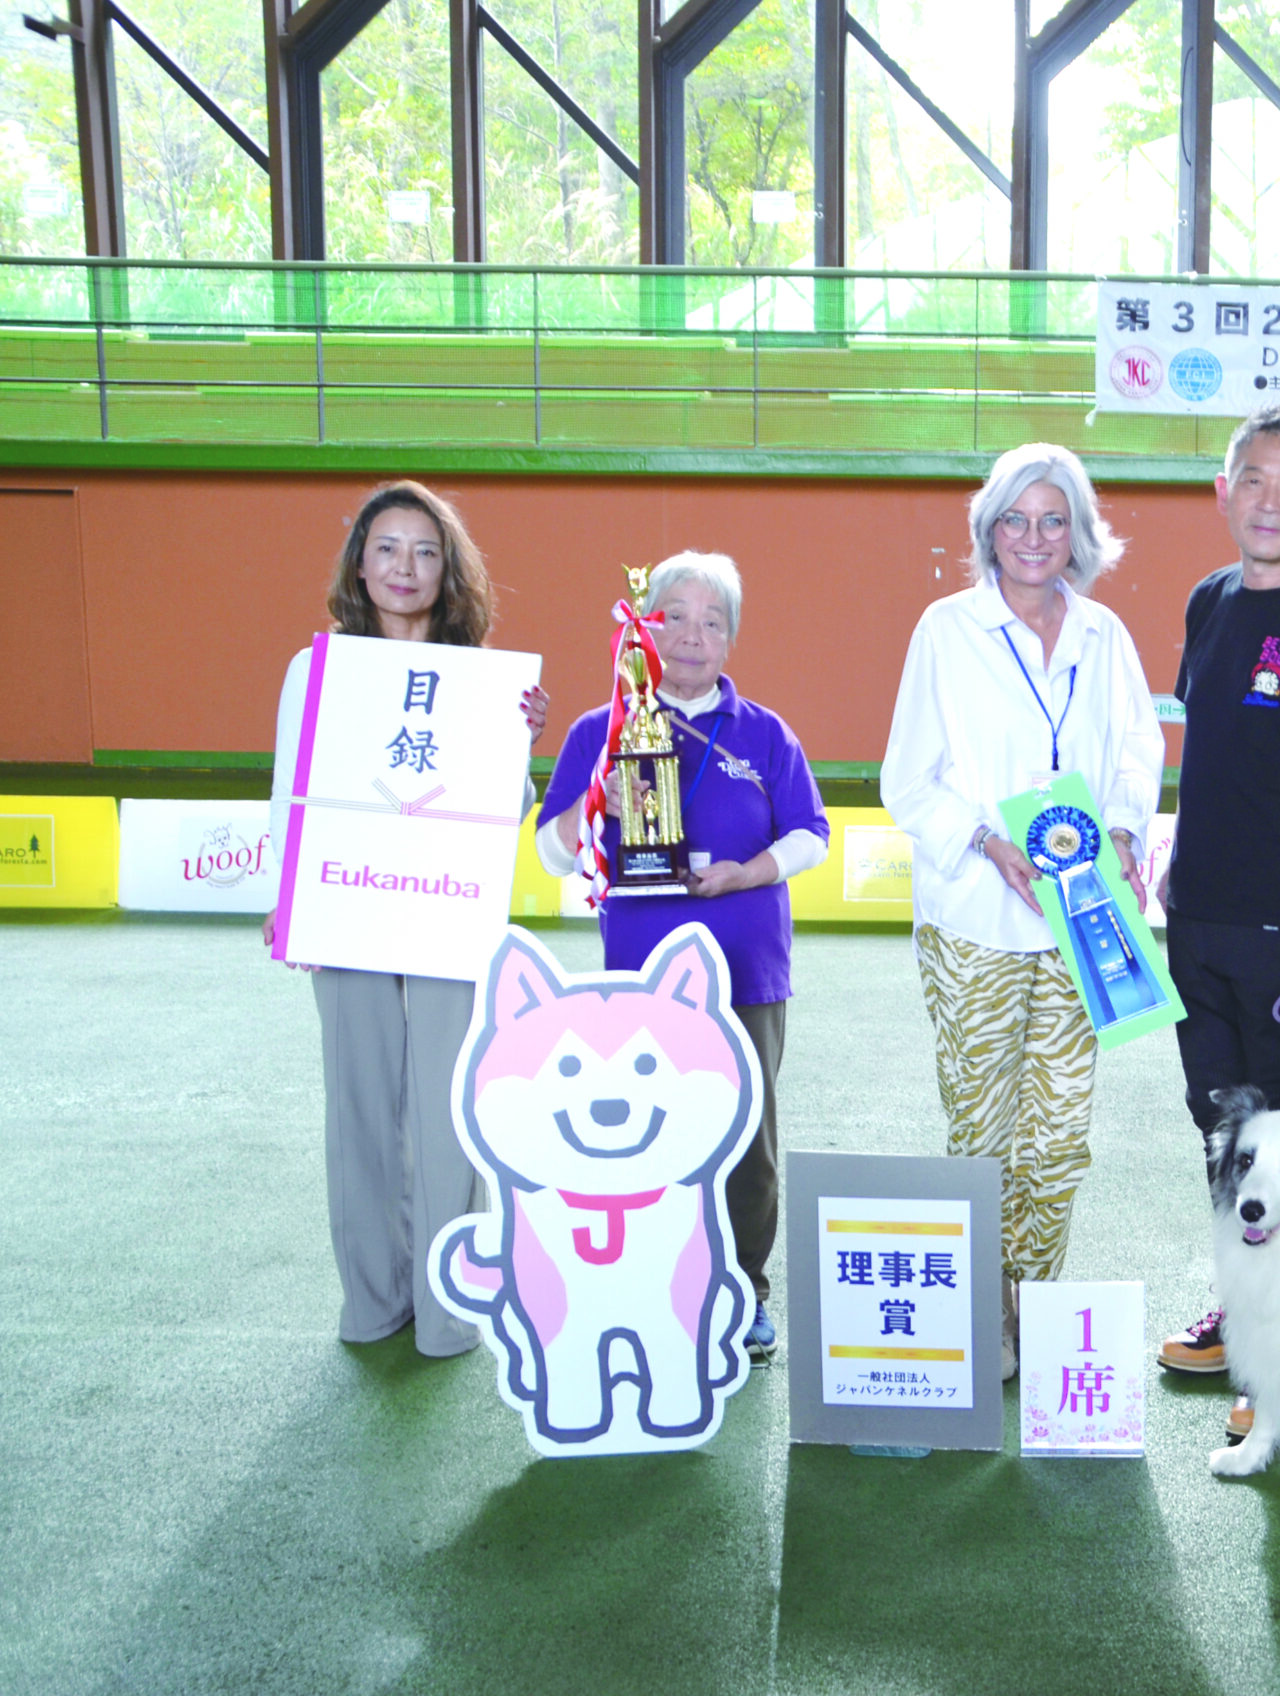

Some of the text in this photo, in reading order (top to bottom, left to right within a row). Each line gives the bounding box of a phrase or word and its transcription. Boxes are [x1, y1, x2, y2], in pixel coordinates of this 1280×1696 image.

[1115, 297, 1150, 332] 第
[1171, 301, 1195, 333] 3
[1214, 301, 1249, 336] 回
[1122, 357, 1151, 387] JKC
[385, 668, 441, 774] 目録
[320, 860, 480, 899] Eukanuba
[836, 1250, 958, 1290] 理事長
[879, 1298, 917, 1336] 賞
[1075, 1307, 1098, 1353] 1
[836, 1383, 958, 1398] ジャパンケネルクラブ
[857, 1371, 931, 1384] 一般社団法人
[1057, 1361, 1115, 1417] 席
